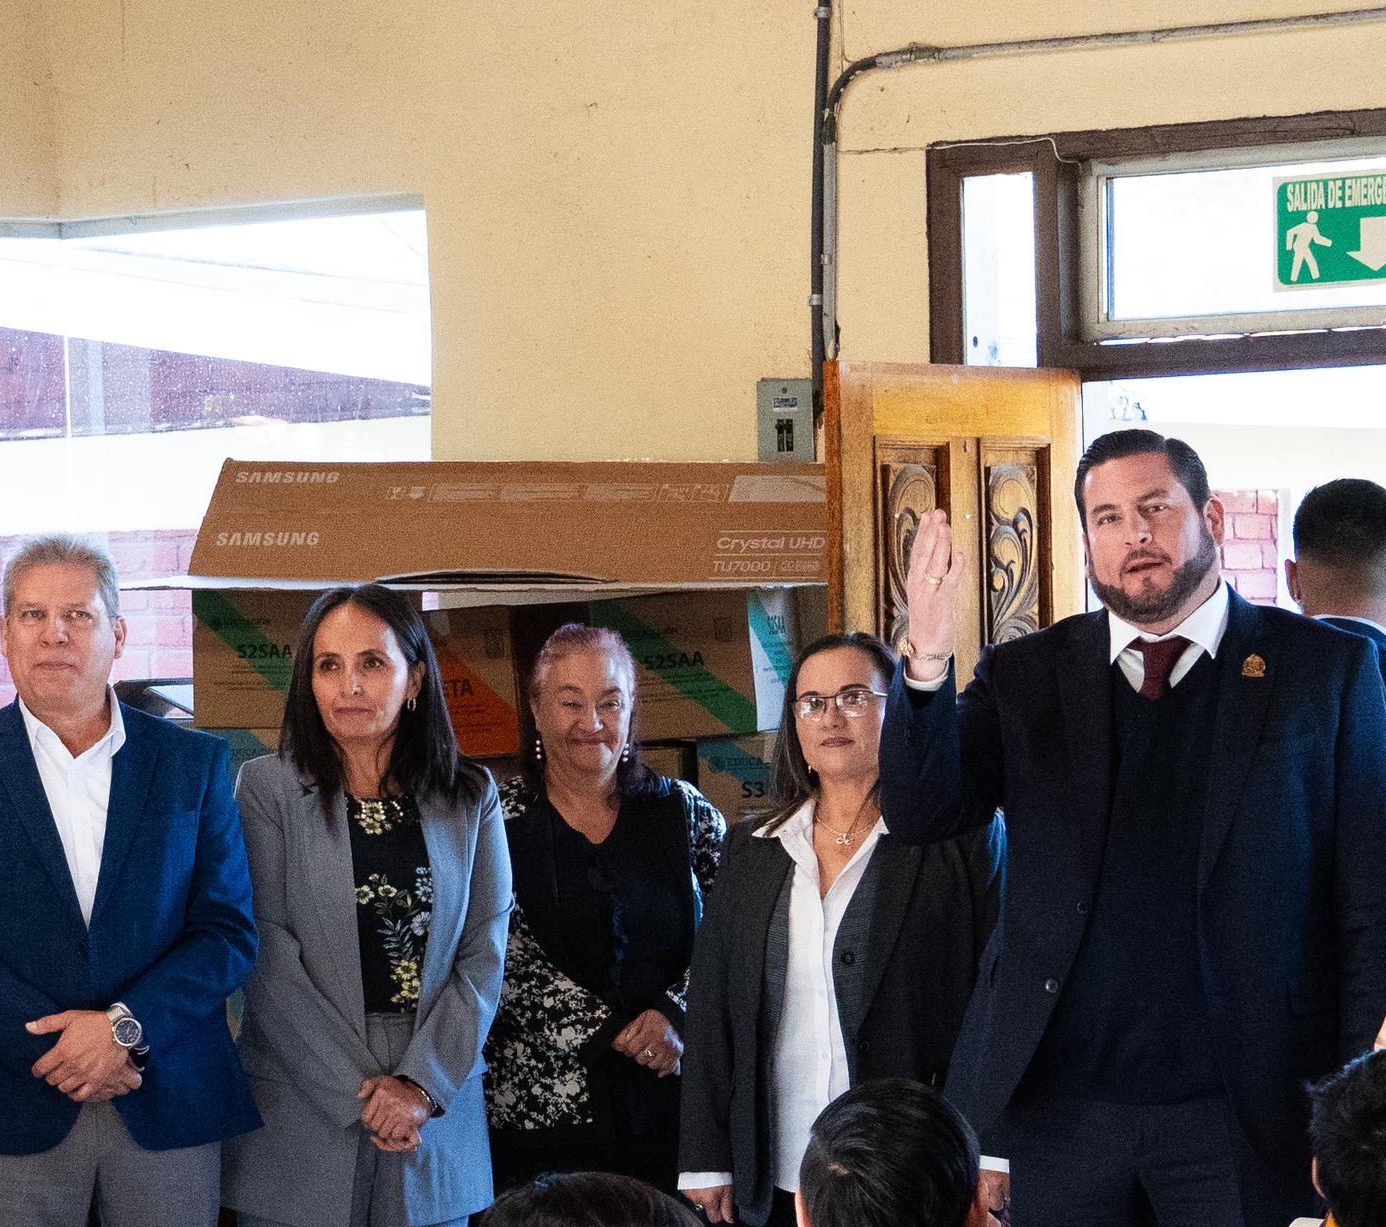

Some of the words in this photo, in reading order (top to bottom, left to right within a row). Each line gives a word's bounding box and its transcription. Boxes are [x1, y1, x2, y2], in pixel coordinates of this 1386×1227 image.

[1286, 181, 1325, 212] SALIDA
[1328, 180, 1342, 208] DE
[235, 471, 340, 484] SAMSUNG
[216, 531, 320, 546] SAMSUNG
[717, 537, 786, 554] Crystal
[789, 537, 826, 549] UHD
[713, 560, 770, 572] TU7000
